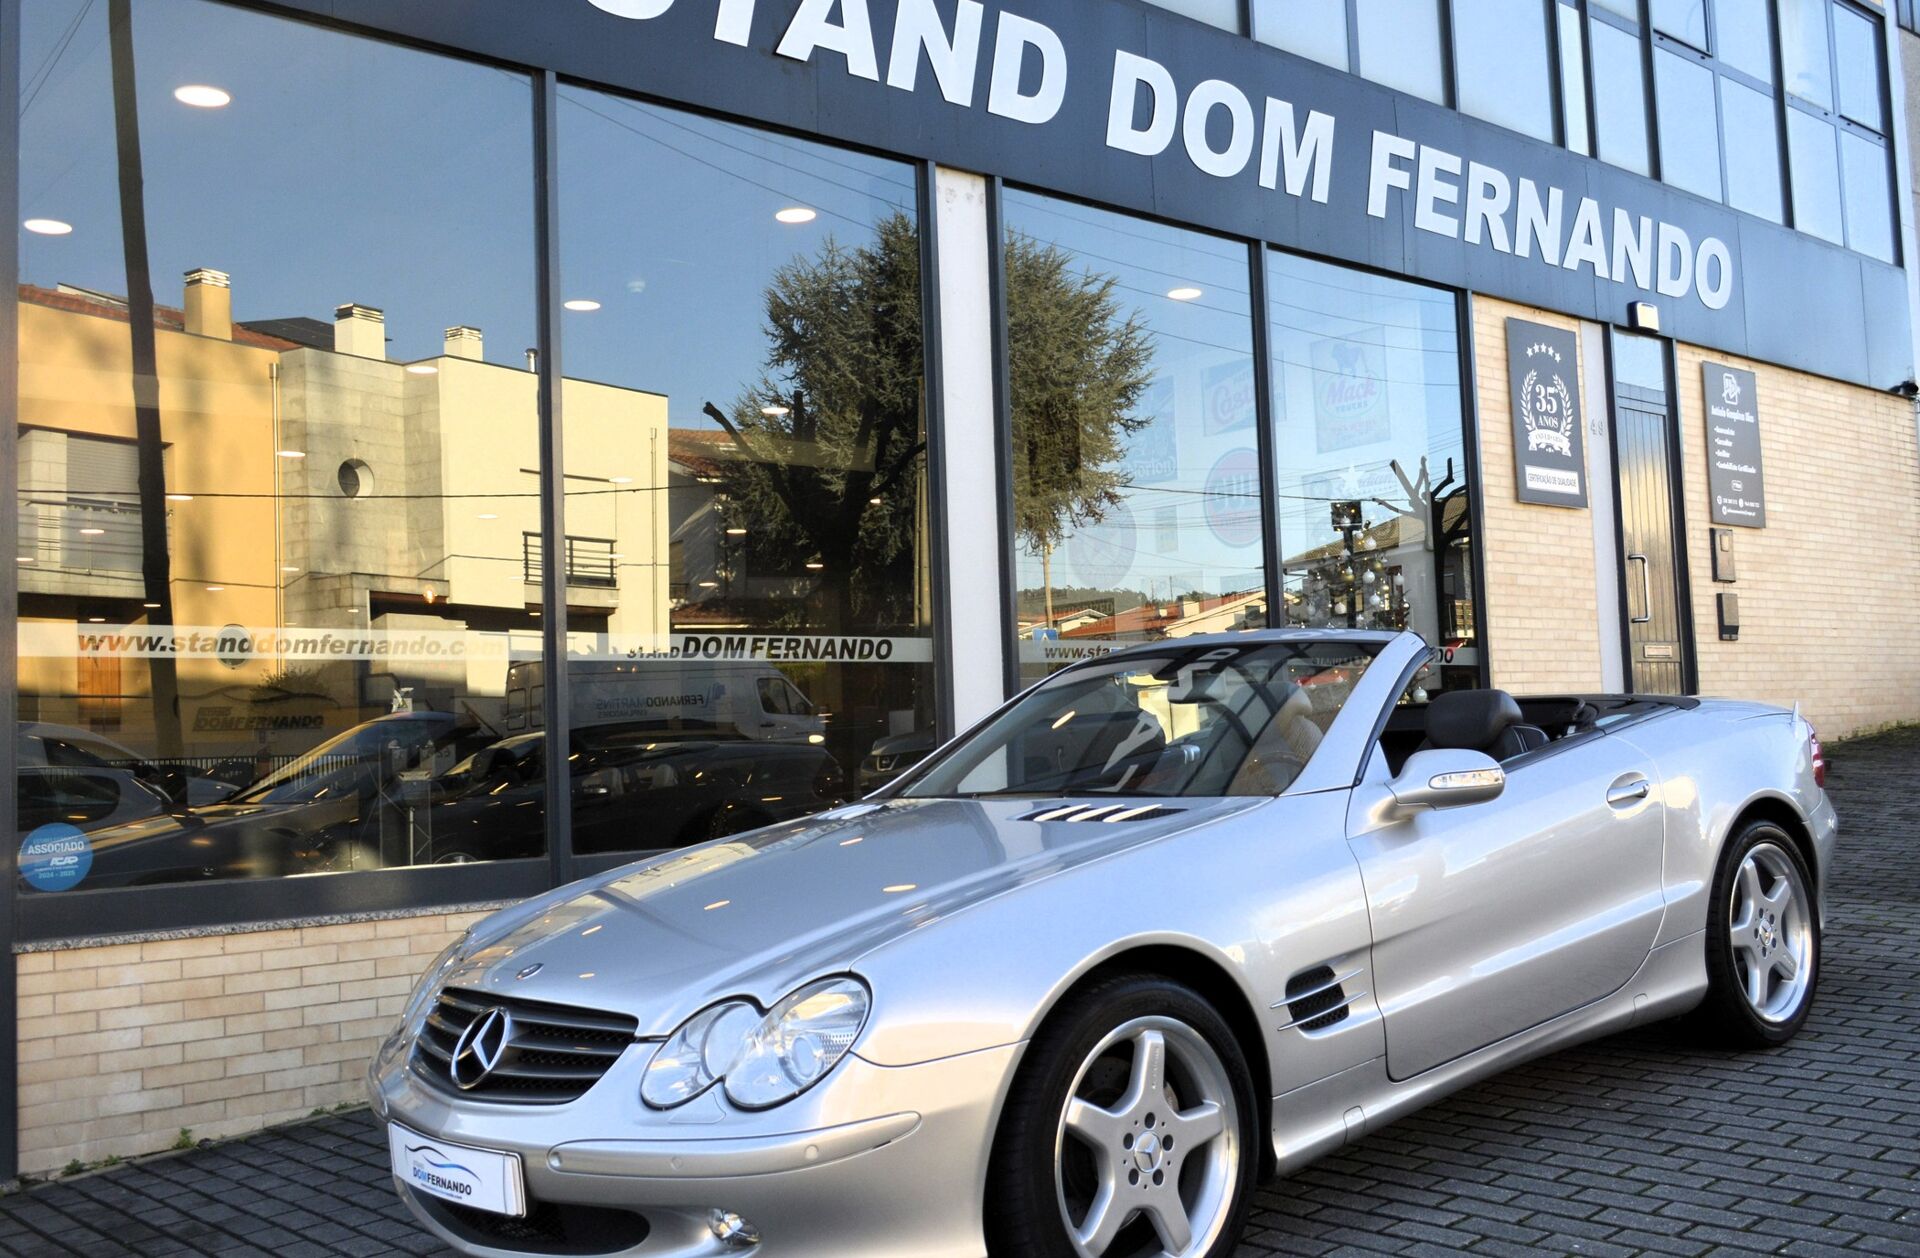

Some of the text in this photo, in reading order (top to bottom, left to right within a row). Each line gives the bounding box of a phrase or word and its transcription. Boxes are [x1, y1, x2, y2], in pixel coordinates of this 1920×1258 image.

[584, 0, 1734, 310] AND DOM FERNANDO
[1535, 384, 1558, 413] 35
[1538, 415, 1559, 429] ANOS
[27, 840, 85, 855] ASSOCIADO
